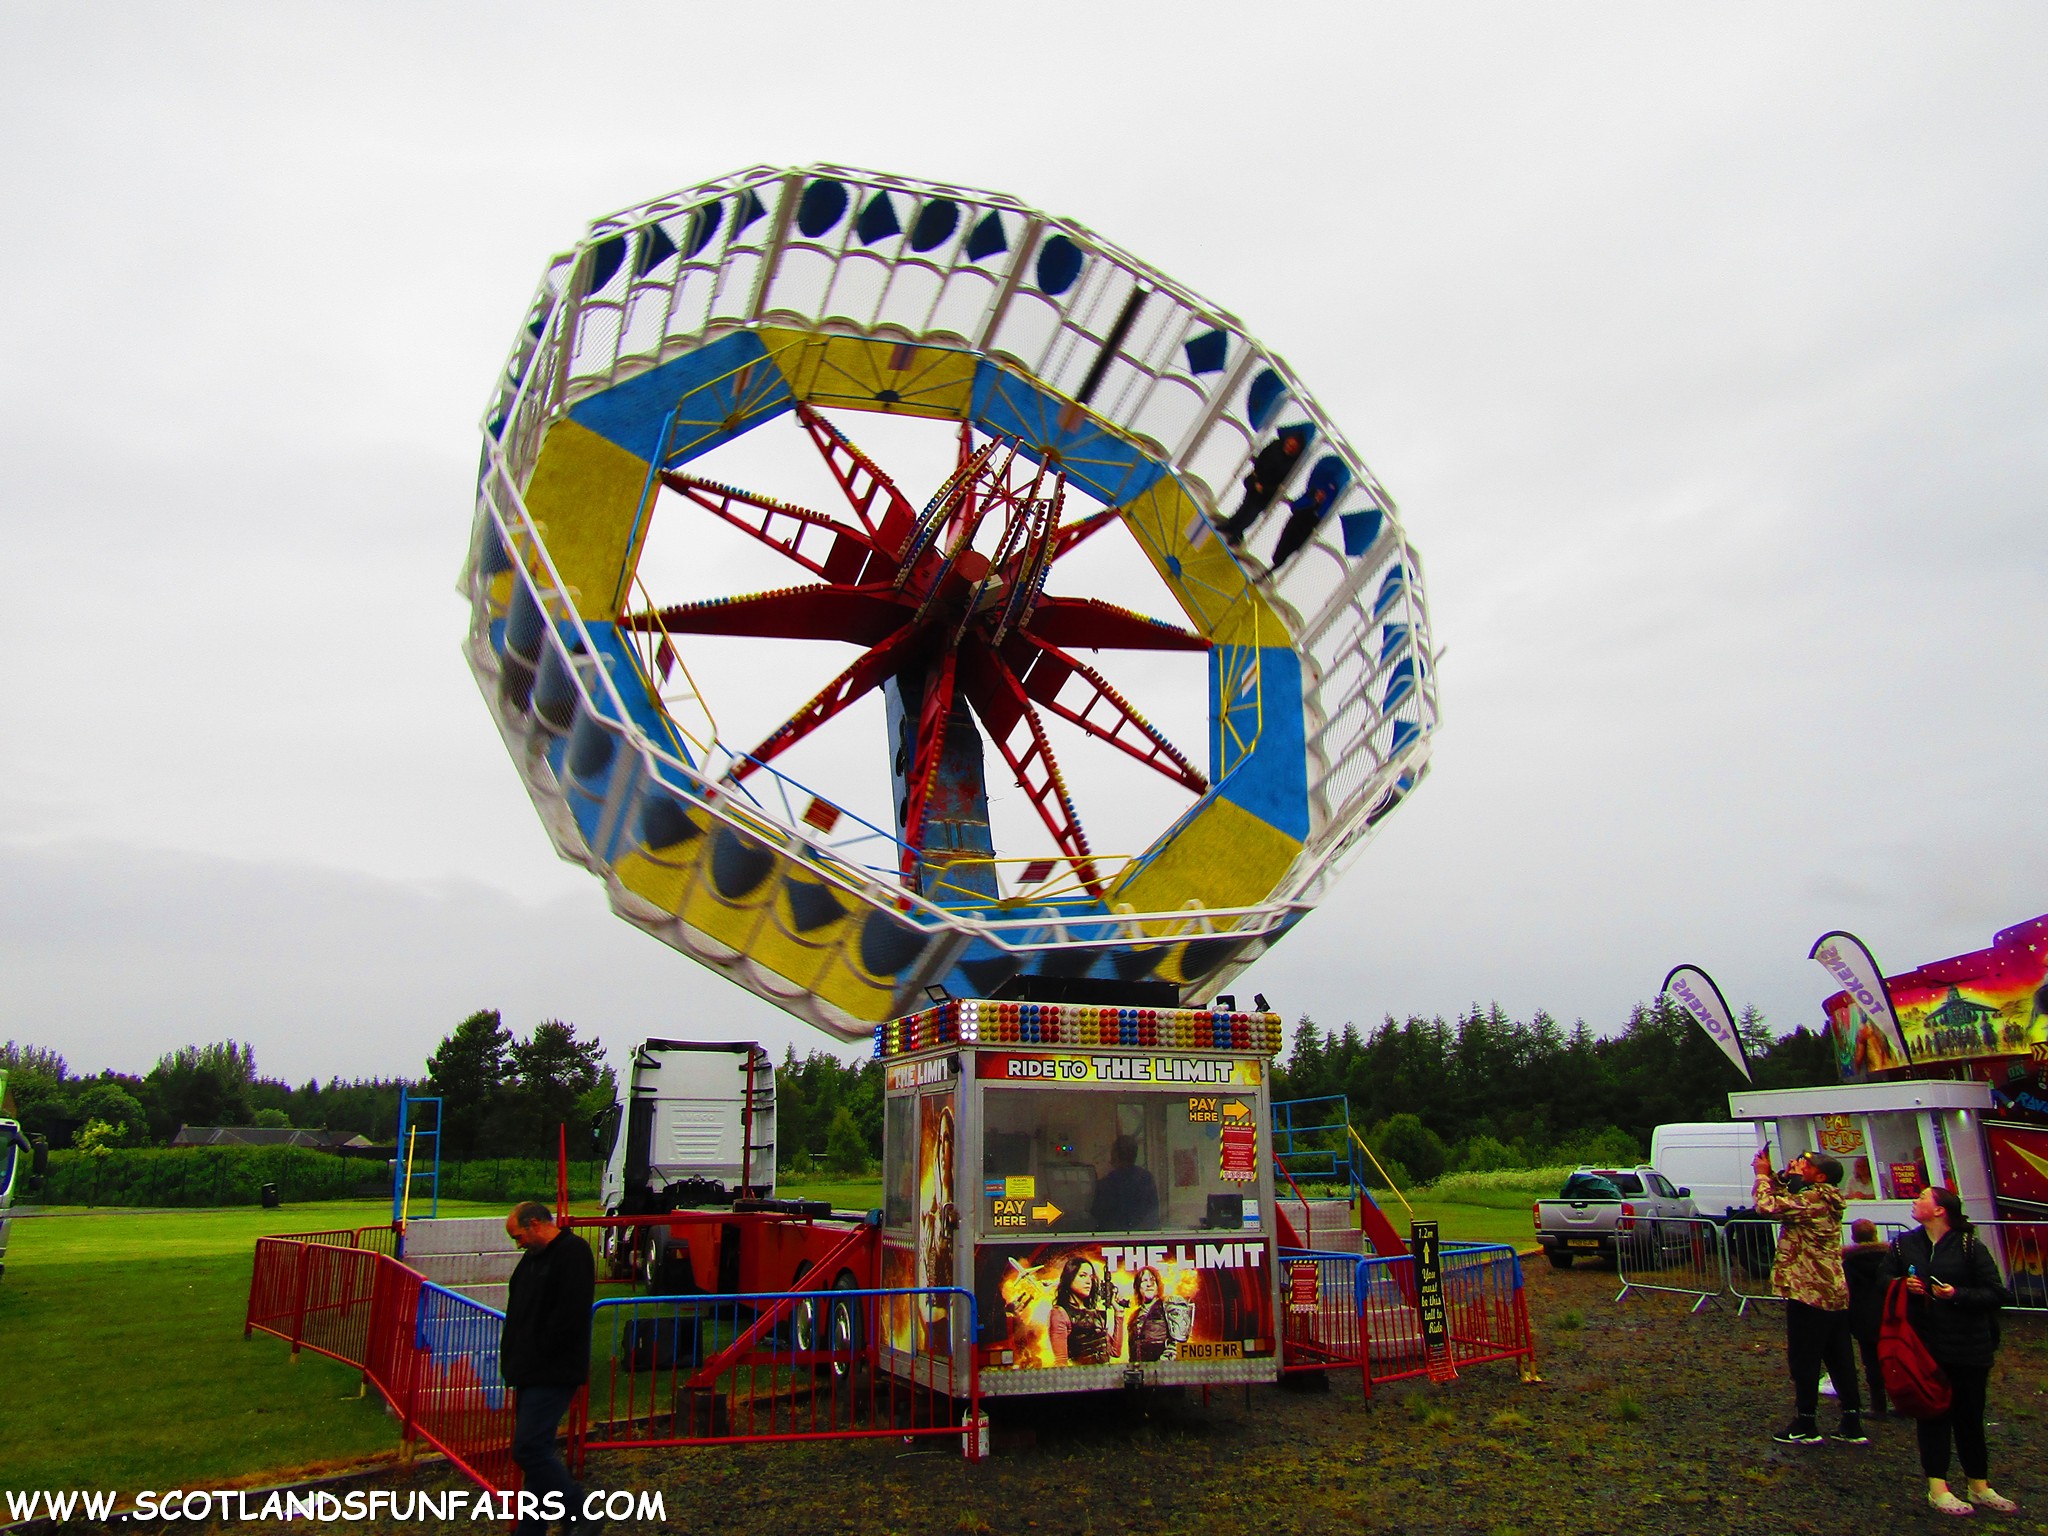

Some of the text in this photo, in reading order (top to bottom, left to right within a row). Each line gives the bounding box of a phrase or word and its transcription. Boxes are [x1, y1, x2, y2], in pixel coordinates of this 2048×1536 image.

[894, 1057, 948, 1089] THE LIMIT
[1008, 1056, 1234, 1083] RIDE TO THE LIMIT
[1189, 1098, 1217, 1111] PAY
[1189, 1112, 1218, 1122] HERE
[994, 1200, 1026, 1214] PAY
[994, 1215, 1027, 1226] HERE
[1418, 1227, 1434, 1239] 1.2m
[1101, 1243, 1264, 1272] THE LIMIT
[1421, 1268, 1436, 1284] You
[1421, 1282, 1438, 1293] must
[1421, 1294, 1442, 1307] be this
[1424, 1308, 1443, 1321] tall to
[1428, 1323, 1443, 1334] Ride
[1181, 1343, 1238, 1358] FN09 FWR
